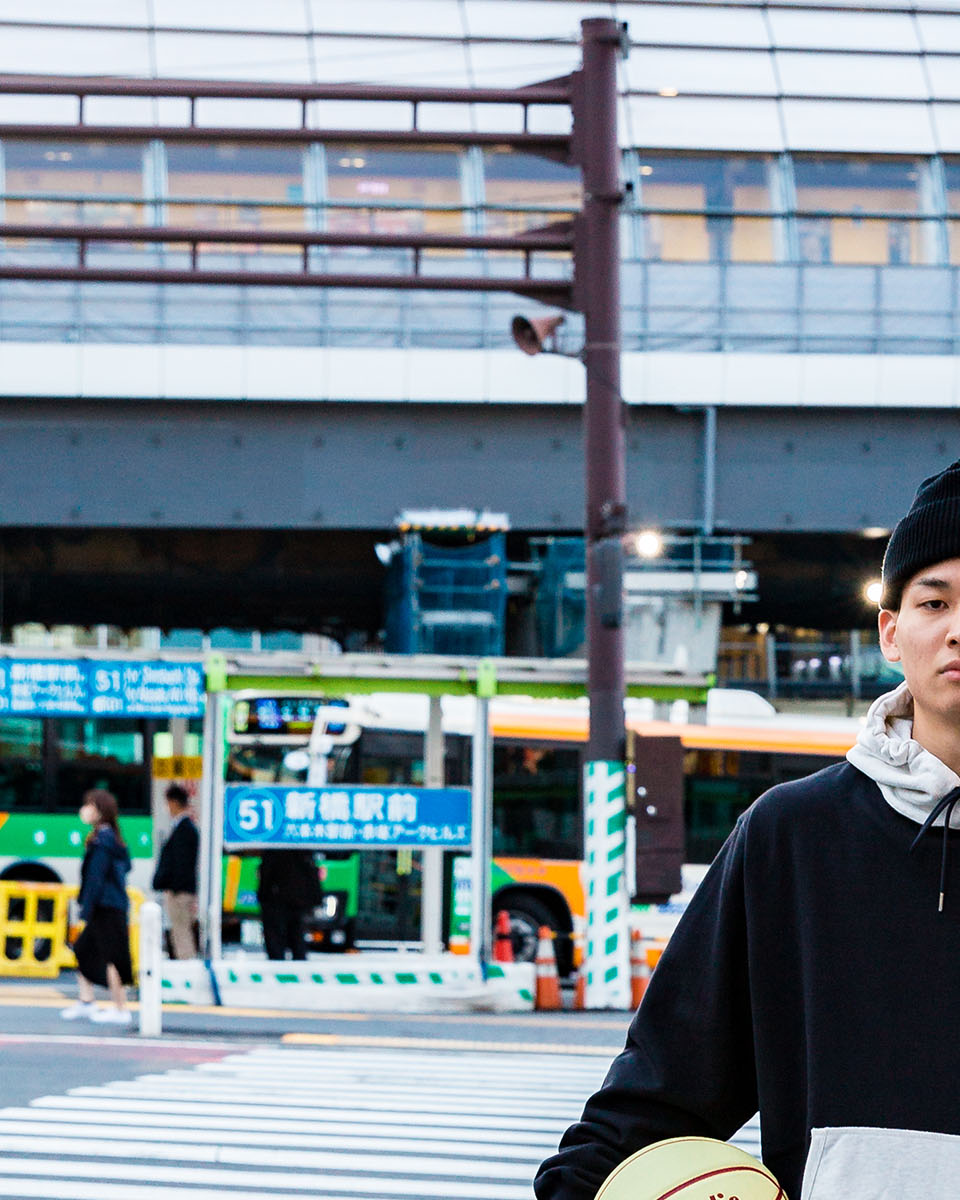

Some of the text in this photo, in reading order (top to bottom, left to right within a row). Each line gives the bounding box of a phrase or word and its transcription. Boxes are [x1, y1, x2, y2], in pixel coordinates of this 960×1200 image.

[238, 799, 273, 831] 51
[284, 791, 417, 822] 新橋駅前
